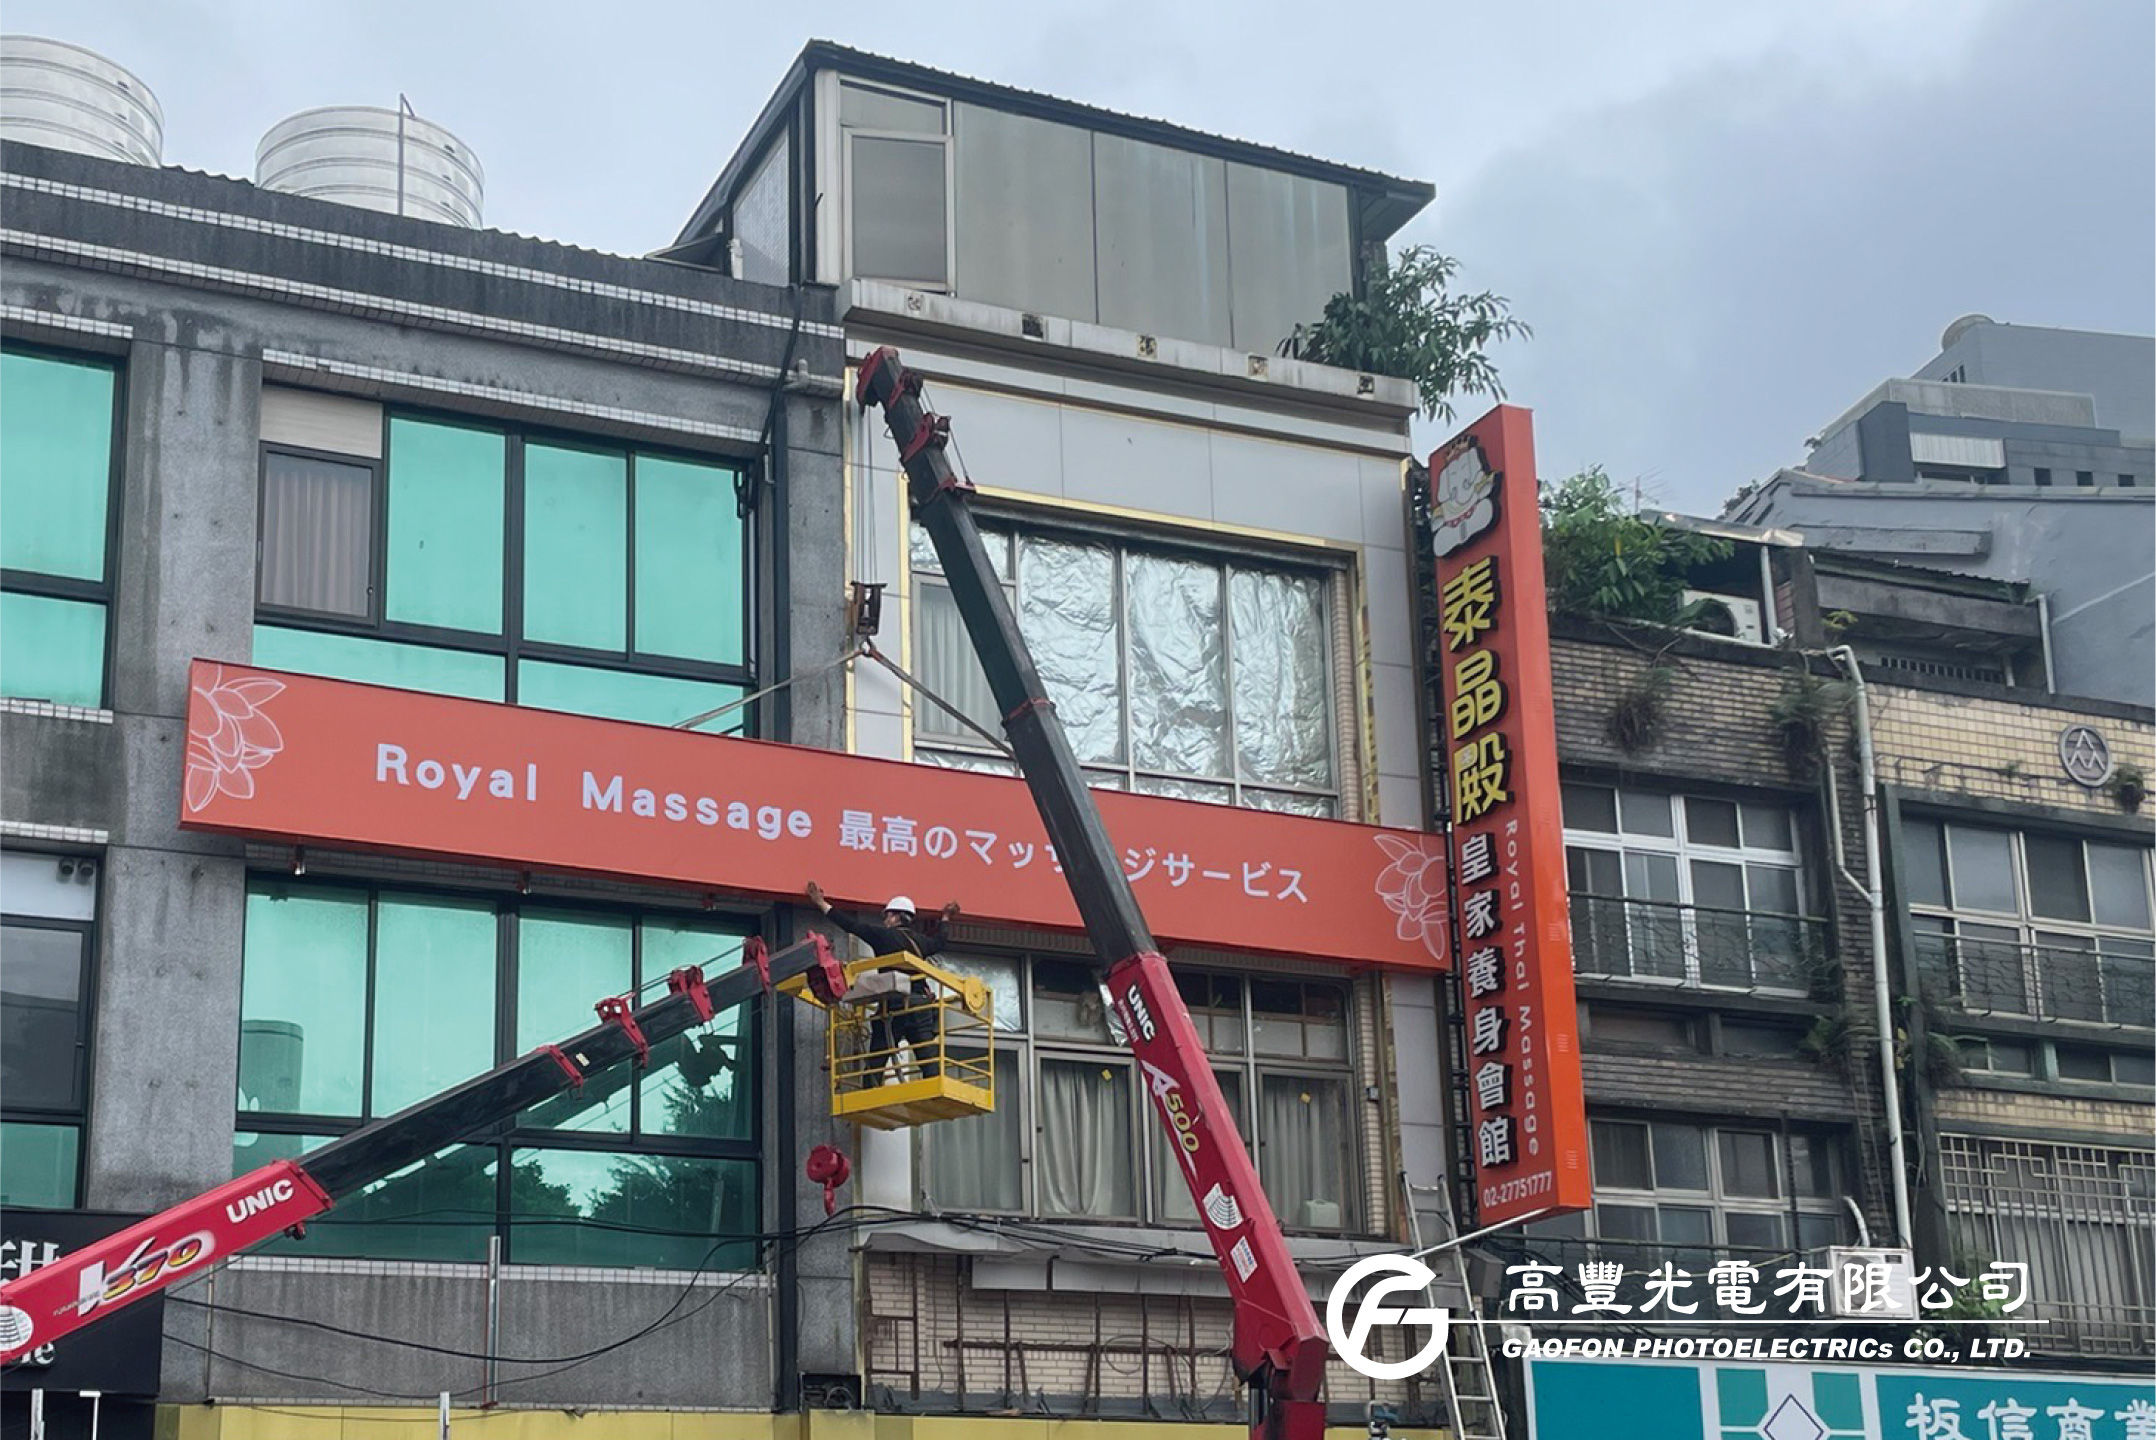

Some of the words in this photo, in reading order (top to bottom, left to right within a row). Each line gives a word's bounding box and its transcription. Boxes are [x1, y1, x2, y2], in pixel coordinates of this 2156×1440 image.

[1441, 556, 1507, 826] 泰晶殿
[375, 743, 537, 801] Royal
[581, 771, 813, 841] Massage
[838, 808, 1309, 904] 最高のマッジサービス
[1505, 819, 1524, 911] Royal
[1461, 832, 1511, 1169] 皇家養身會館
[1512, 923, 1529, 992] Thai
[1126, 983, 1156, 1042] UNIC
[1518, 1005, 1539, 1157] Massage
[226, 1178, 295, 1225] UNIC
[1482, 1169, 1552, 1208] 02-27751777
